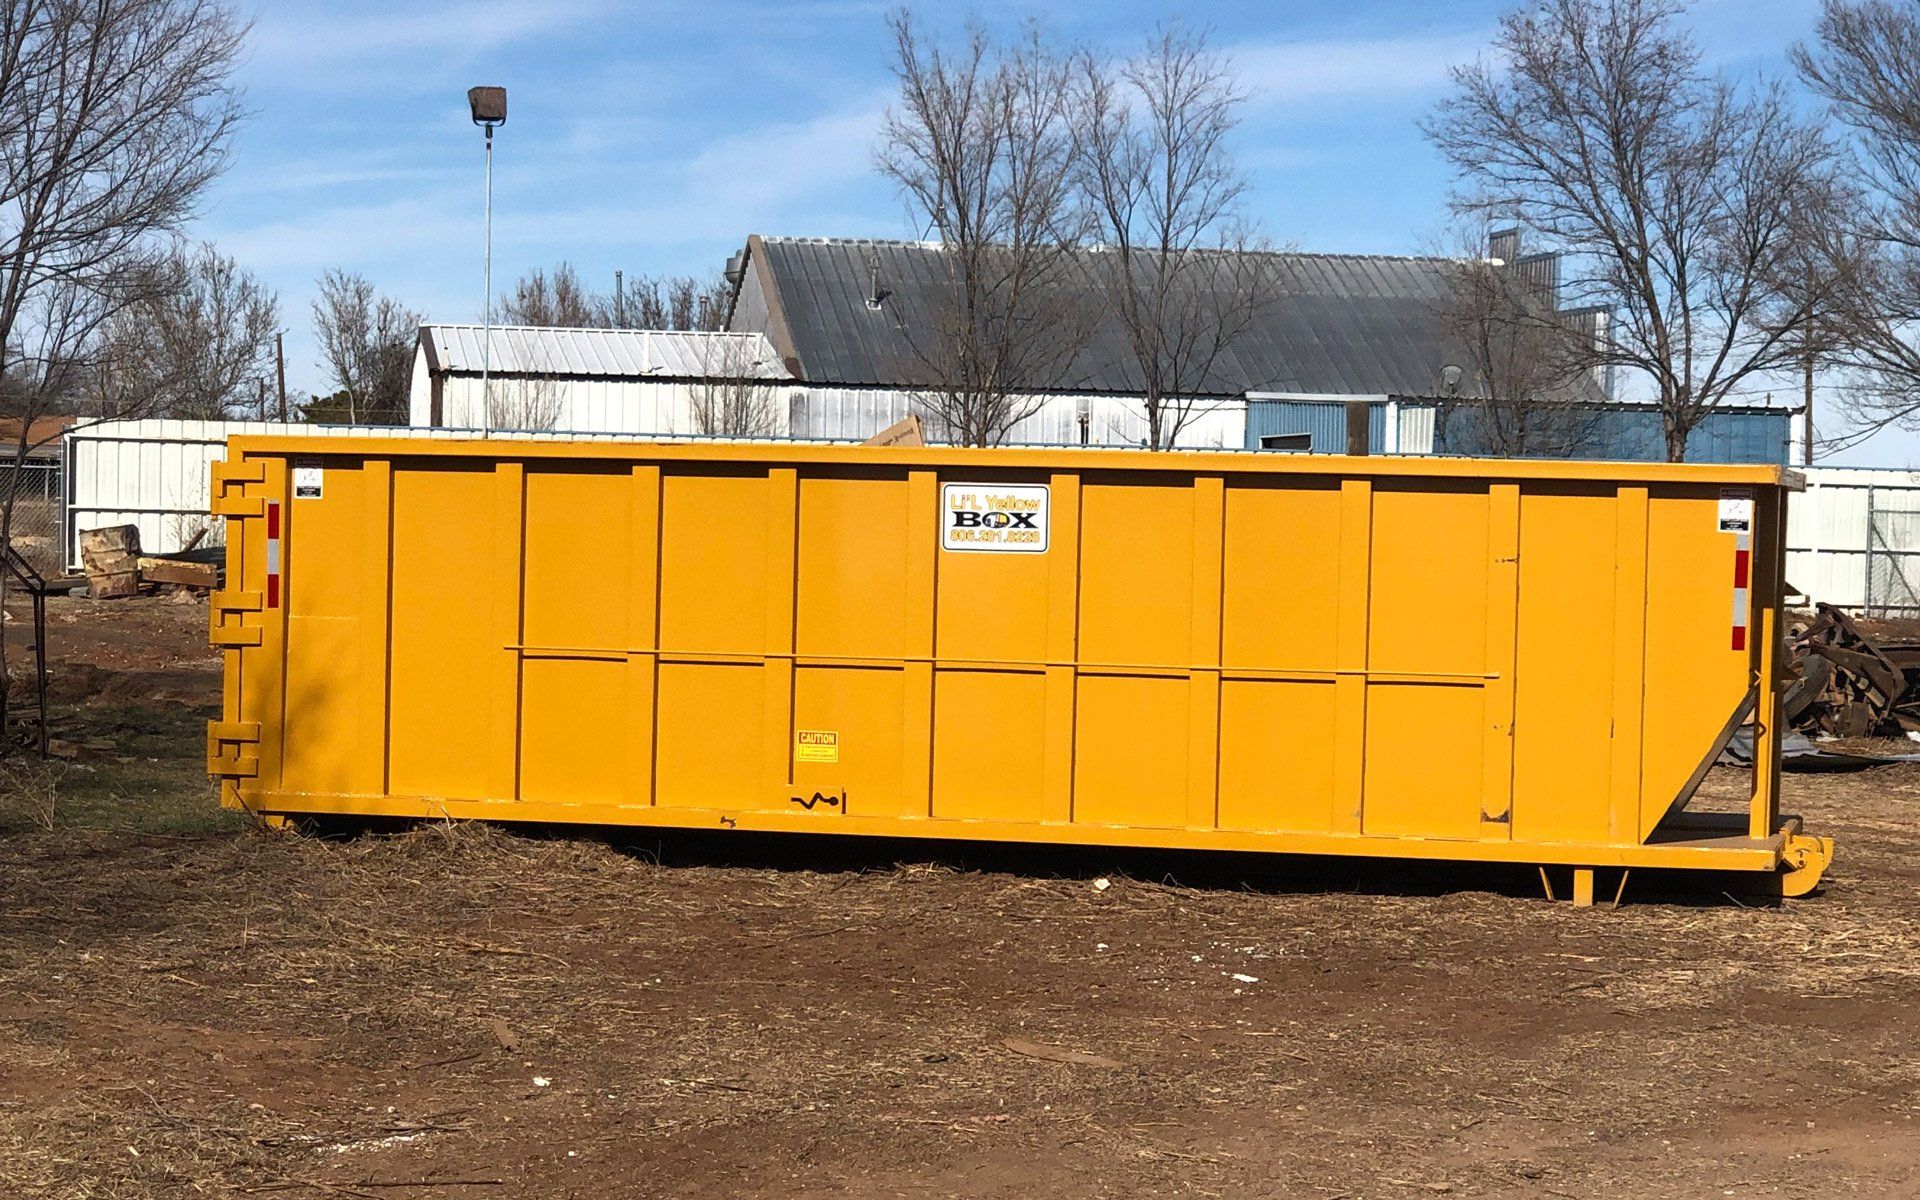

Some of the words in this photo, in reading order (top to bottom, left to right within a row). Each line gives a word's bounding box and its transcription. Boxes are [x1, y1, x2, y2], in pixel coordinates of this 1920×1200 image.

[985, 495, 1040, 511] Yellow
[952, 511, 1039, 529] BOX
[800, 733, 835, 744] CAUTION
